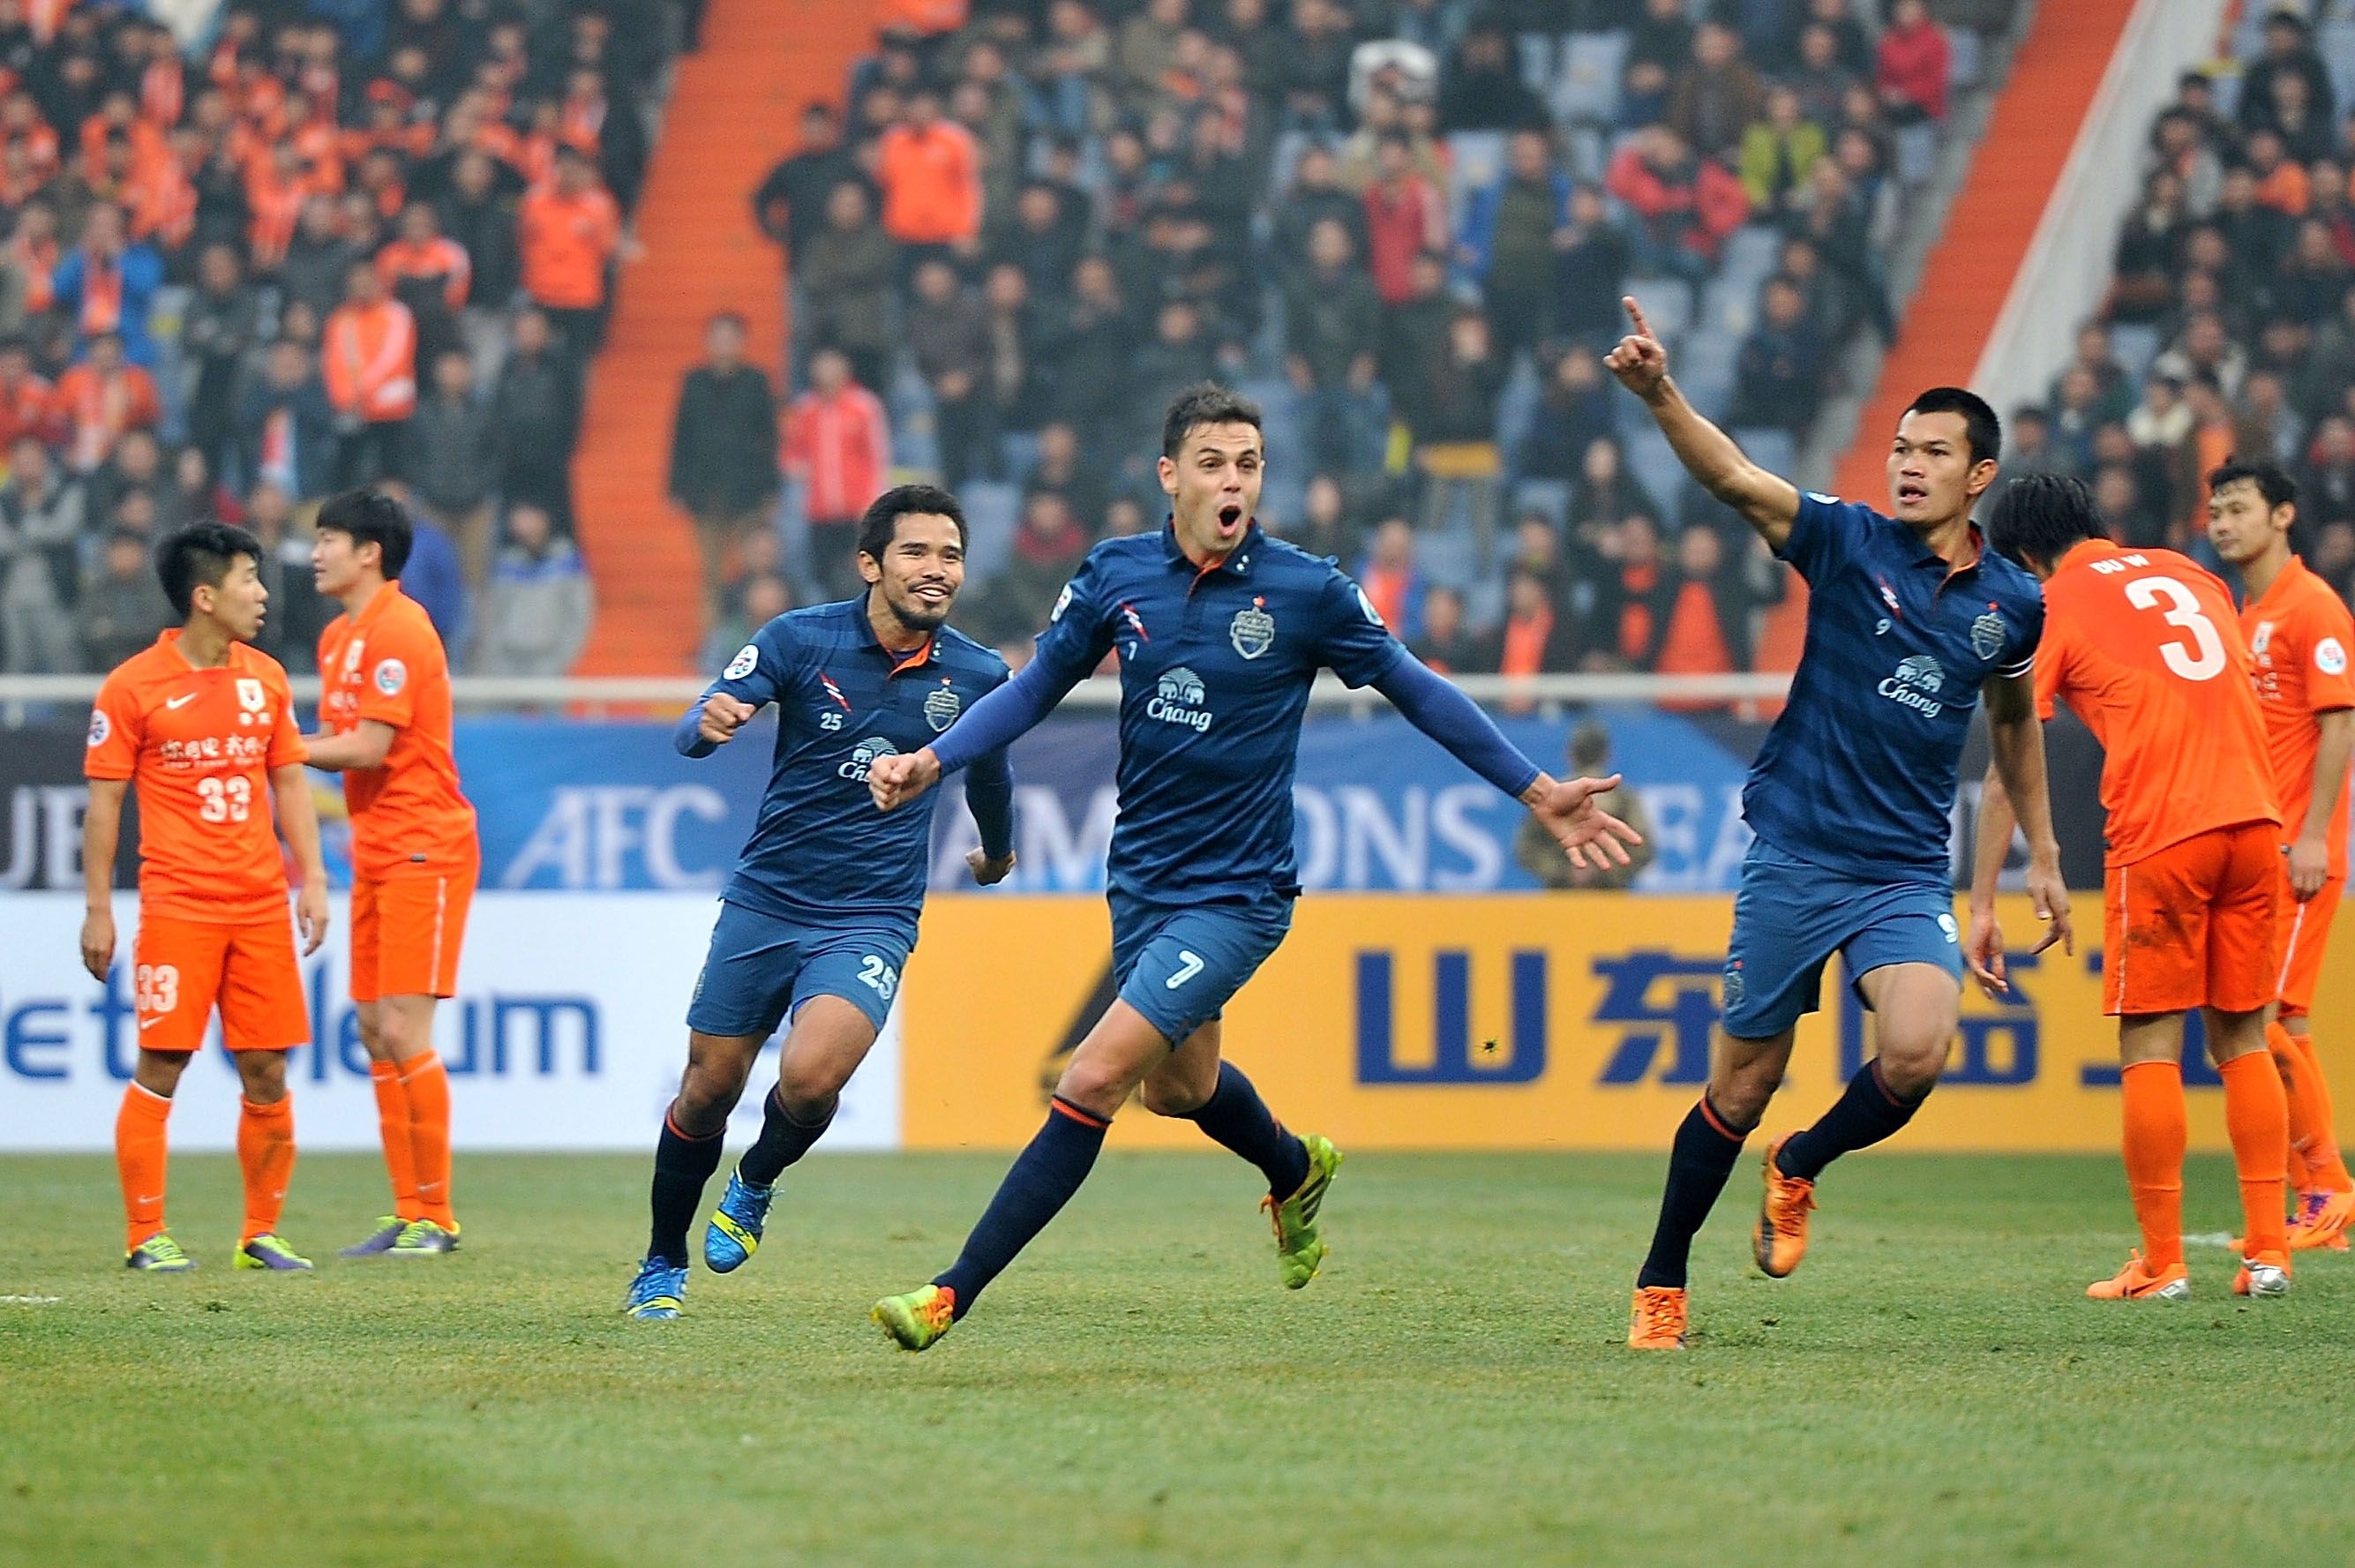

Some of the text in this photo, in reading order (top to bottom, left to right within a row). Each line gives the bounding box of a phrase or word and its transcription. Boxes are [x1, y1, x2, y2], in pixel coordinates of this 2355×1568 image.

[2089, 559, 2126, 574] DU
[1874, 619, 1891, 635] 9
[2124, 576, 2226, 680] 3
[1146, 696, 1213, 733] Chang
[1877, 677, 1941, 718] Chang
[821, 712, 843, 731] 25
[197, 775, 251, 822] 33
[499, 783, 728, 890] AFC
[137, 964, 179, 1012] 33
[856, 955, 897, 1000] 25
[1165, 949, 1204, 990] 7
